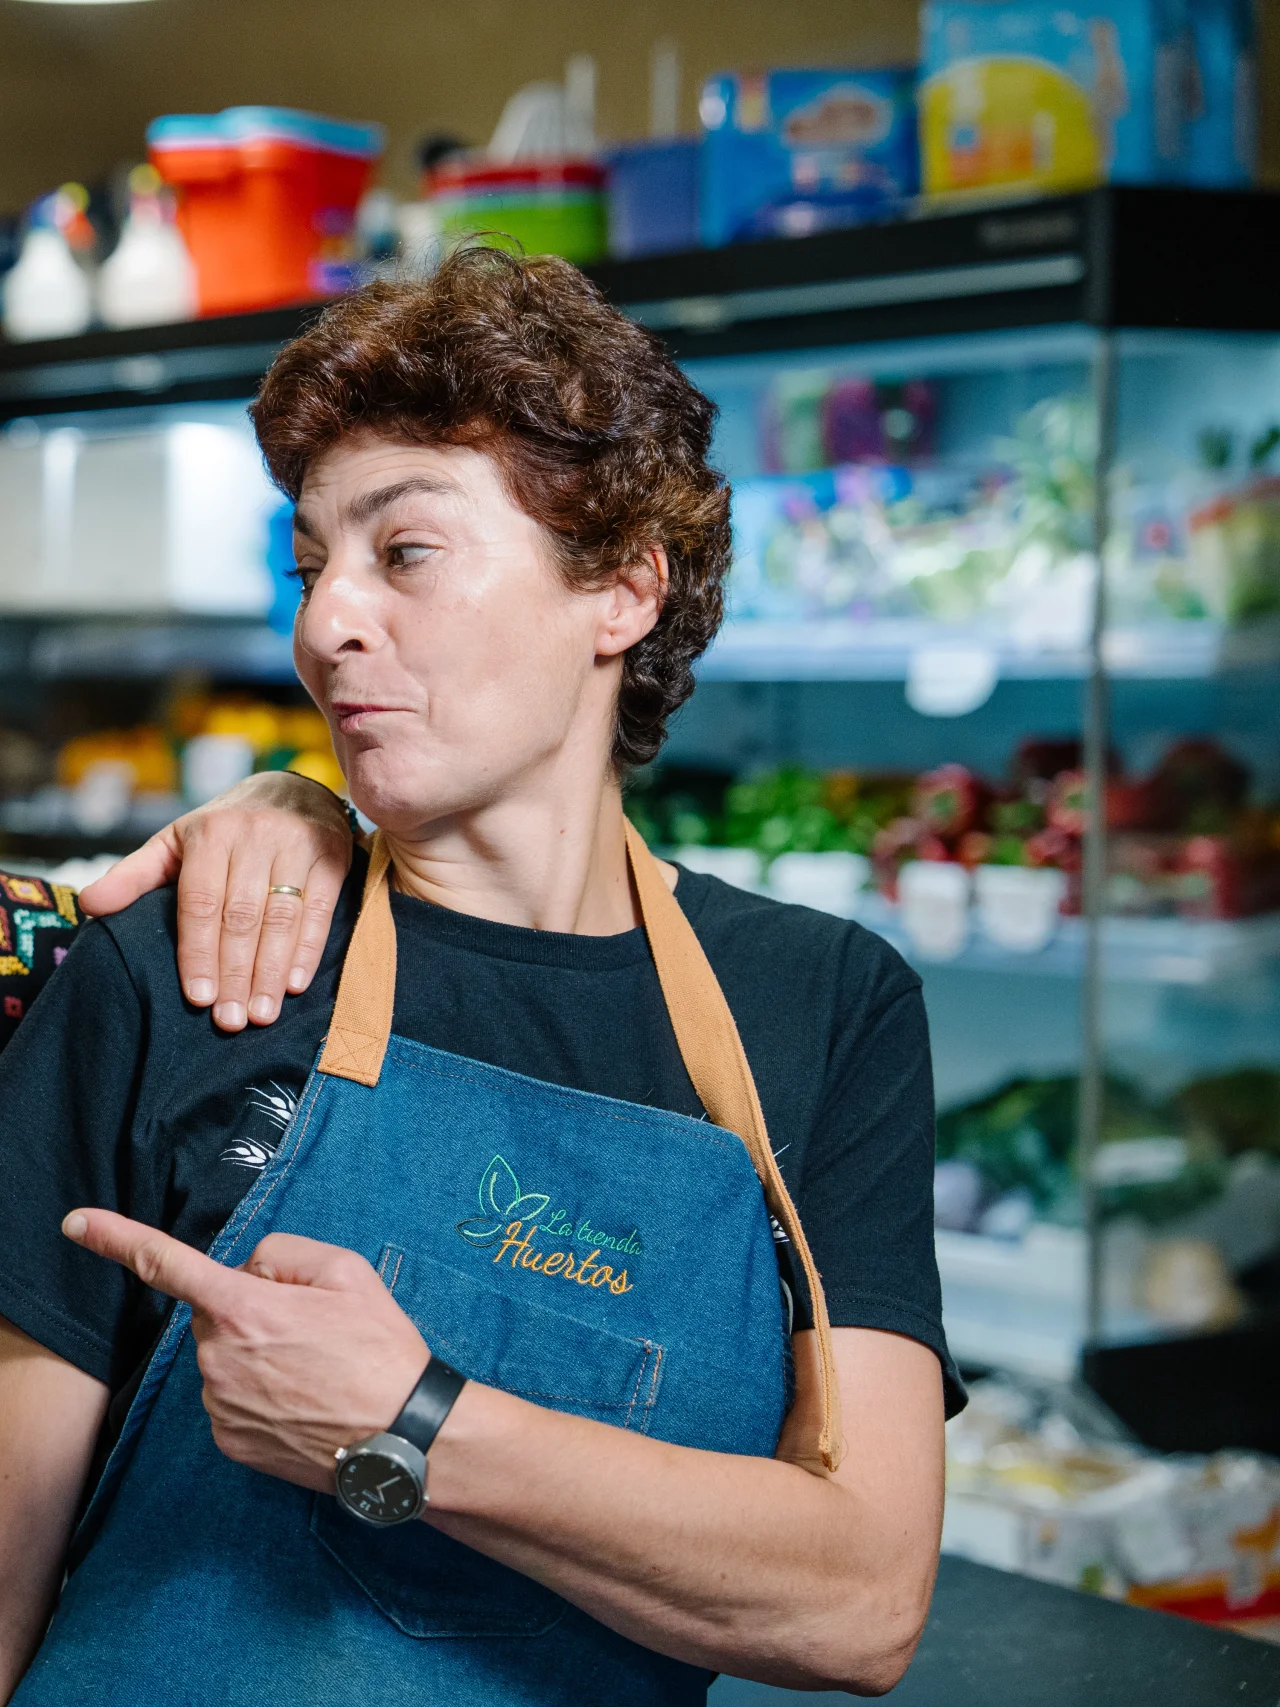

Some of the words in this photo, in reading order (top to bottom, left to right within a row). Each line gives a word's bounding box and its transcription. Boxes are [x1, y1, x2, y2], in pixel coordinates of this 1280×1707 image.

[540, 1209, 572, 1236] La
[577, 1220, 642, 1255] tienda
[494, 1221, 633, 1295] Huertos
[359, 1500, 371, 1512] 12
